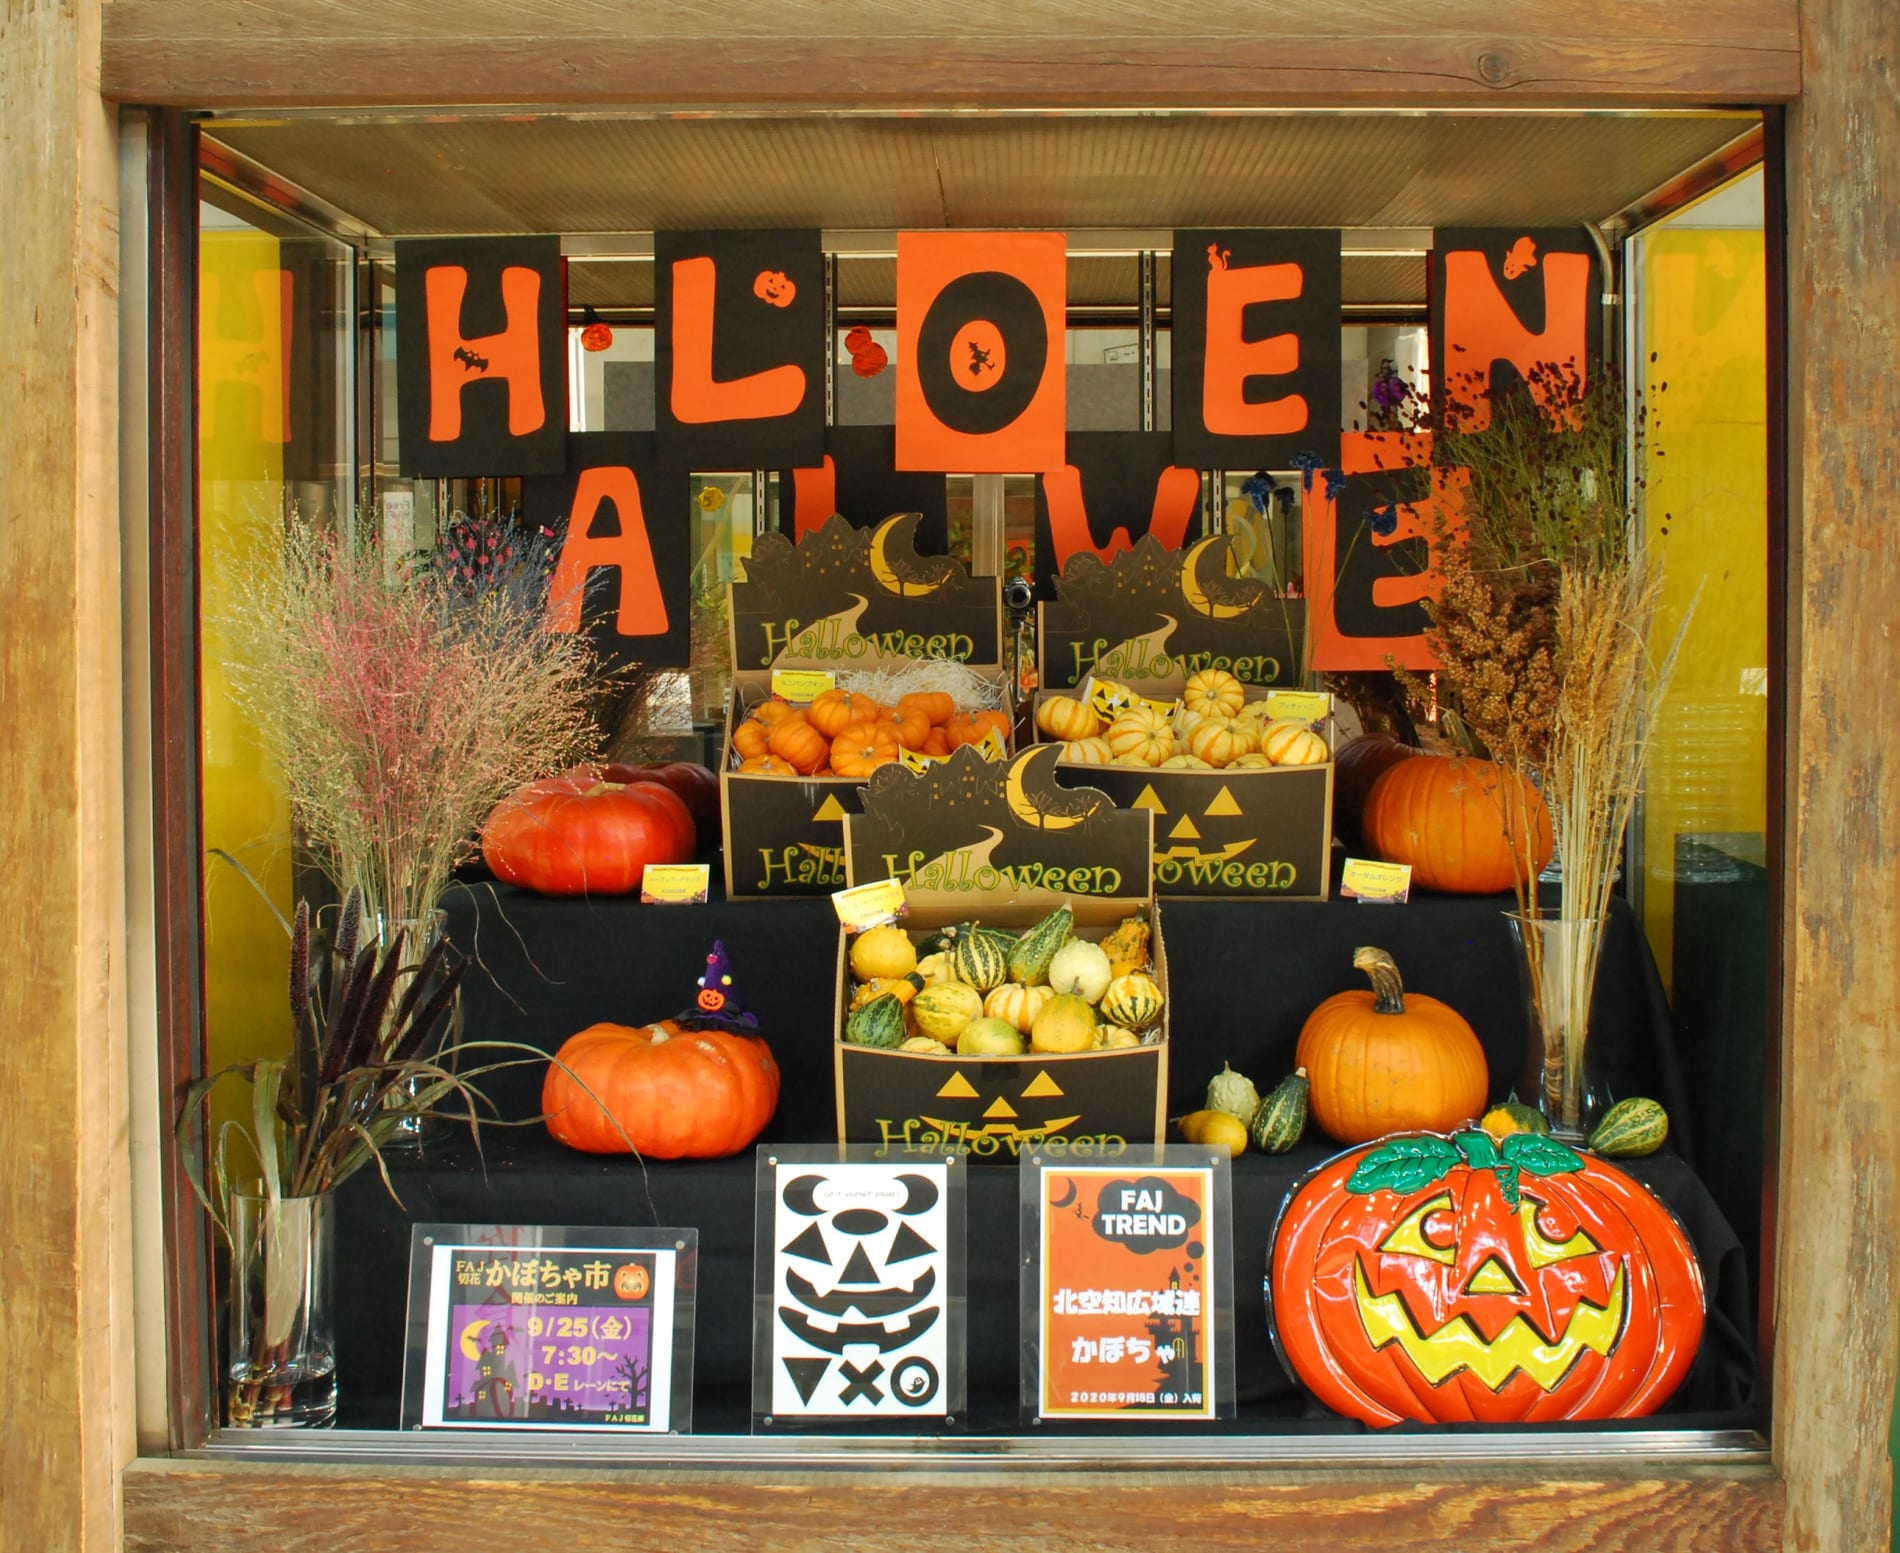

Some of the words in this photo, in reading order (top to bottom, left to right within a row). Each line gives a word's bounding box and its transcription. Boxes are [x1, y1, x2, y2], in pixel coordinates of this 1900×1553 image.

[425, 265, 545, 442] H
[670, 255, 806, 425] L
[916, 270, 1049, 435] O
[1203, 261, 1308, 437] E
[1444, 250, 1590, 434] N
[544, 466, 669, 637] A
[761, 618, 974, 667] Halloween
[1068, 637, 1281, 687] Halloween
[881, 848, 1121, 895] Halloween
[875, 1118, 1127, 1157] Halloween
[1121, 1190, 1163, 1211] FAJ
[1101, 1214, 1187, 1236] TREND
[456, 1261, 485, 1272] FAJ
[457, 1272, 481, 1286] 切花
[485, 1260, 612, 1289] かぼちゃ市
[511, 1292, 579, 1305] 開催のご案内
[1053, 1288, 1200, 1316] 北空知広域連
[527, 1316, 633, 1340] 9/25(金)
[1071, 1336, 1176, 1364] かぼちゃ
